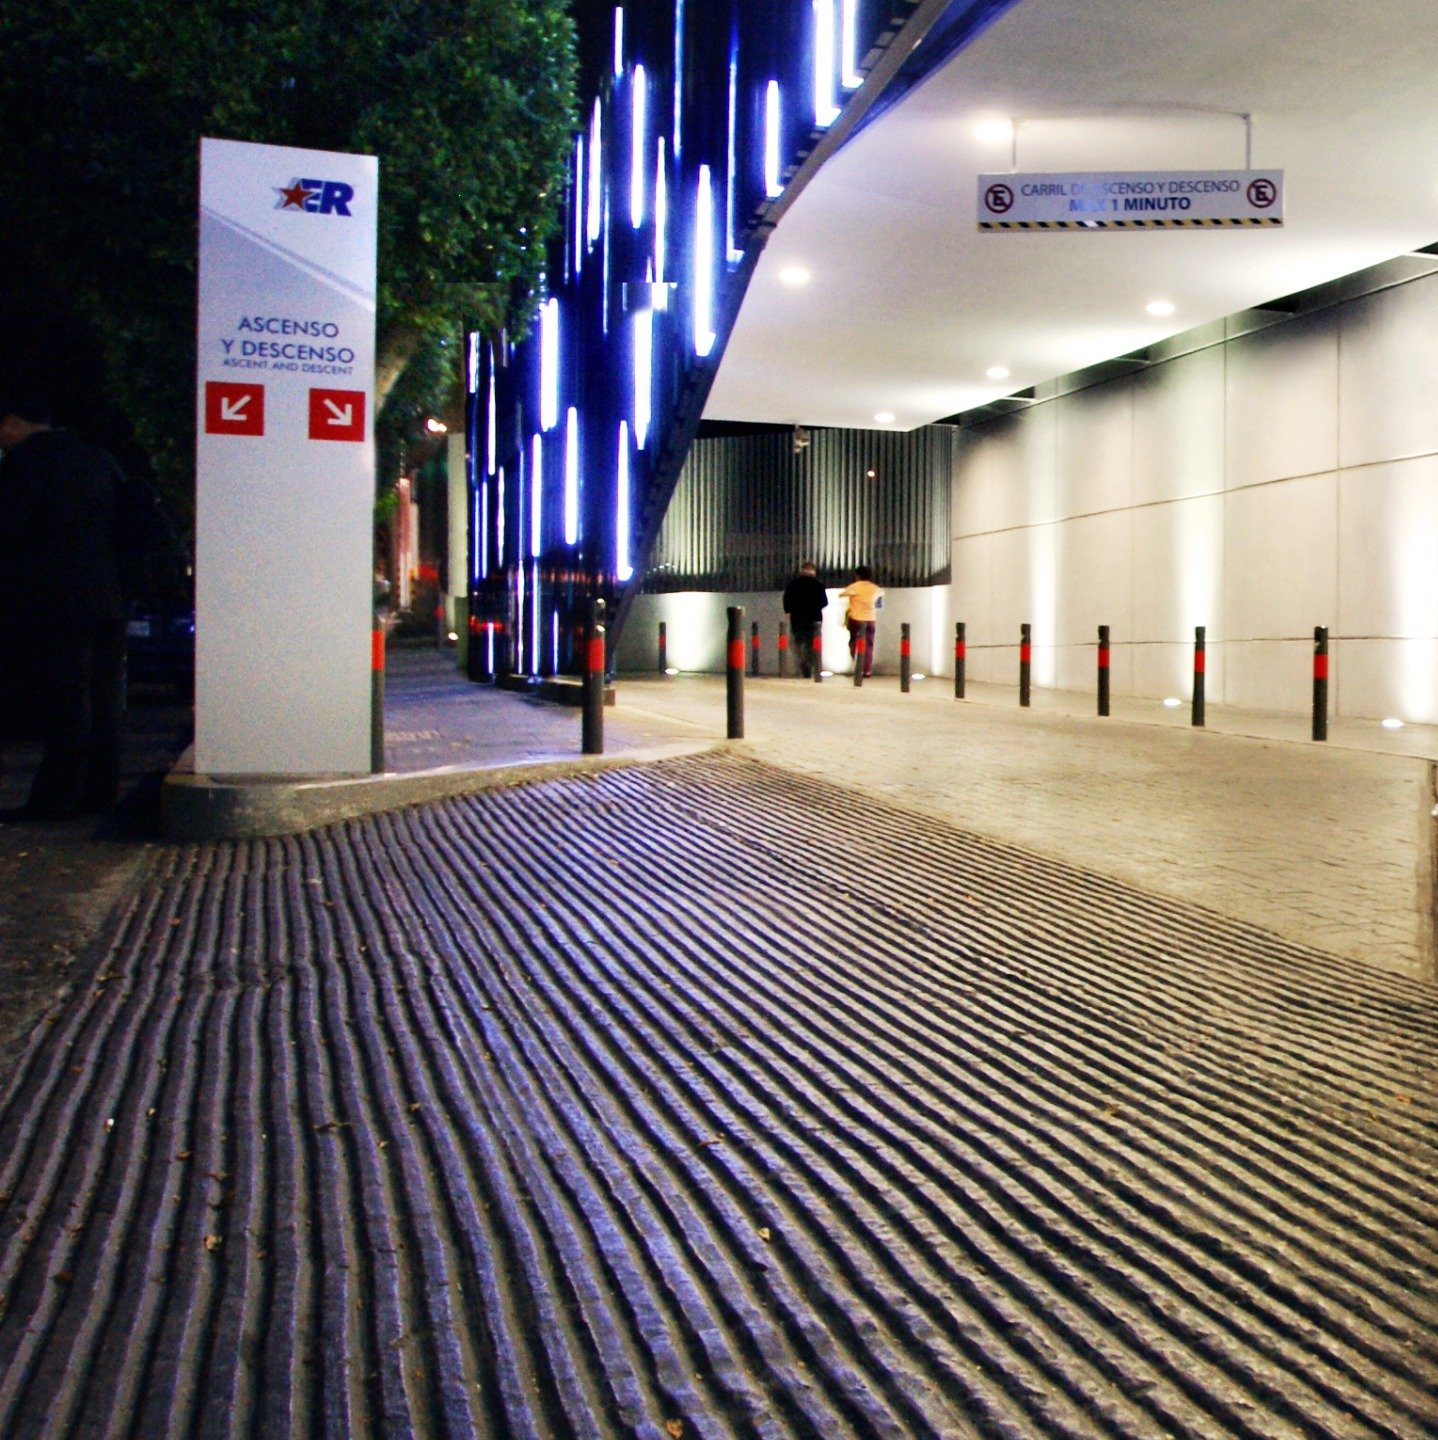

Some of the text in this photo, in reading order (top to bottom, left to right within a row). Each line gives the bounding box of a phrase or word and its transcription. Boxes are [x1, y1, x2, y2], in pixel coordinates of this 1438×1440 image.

[1021, 183, 1067, 197] CARRIL
[1092, 180, 1154, 195] SCENSO
[1156, 181, 1165, 193] Y
[1168, 179, 1240, 193] DESCENSO
[1069, 196, 1191, 212] MX 1 MINUTO
[238, 315, 339, 338] ASCENSO
[221, 338, 355, 364] Y DESCENSO
[223, 358, 353, 375] ASCENT AND DESCENT
